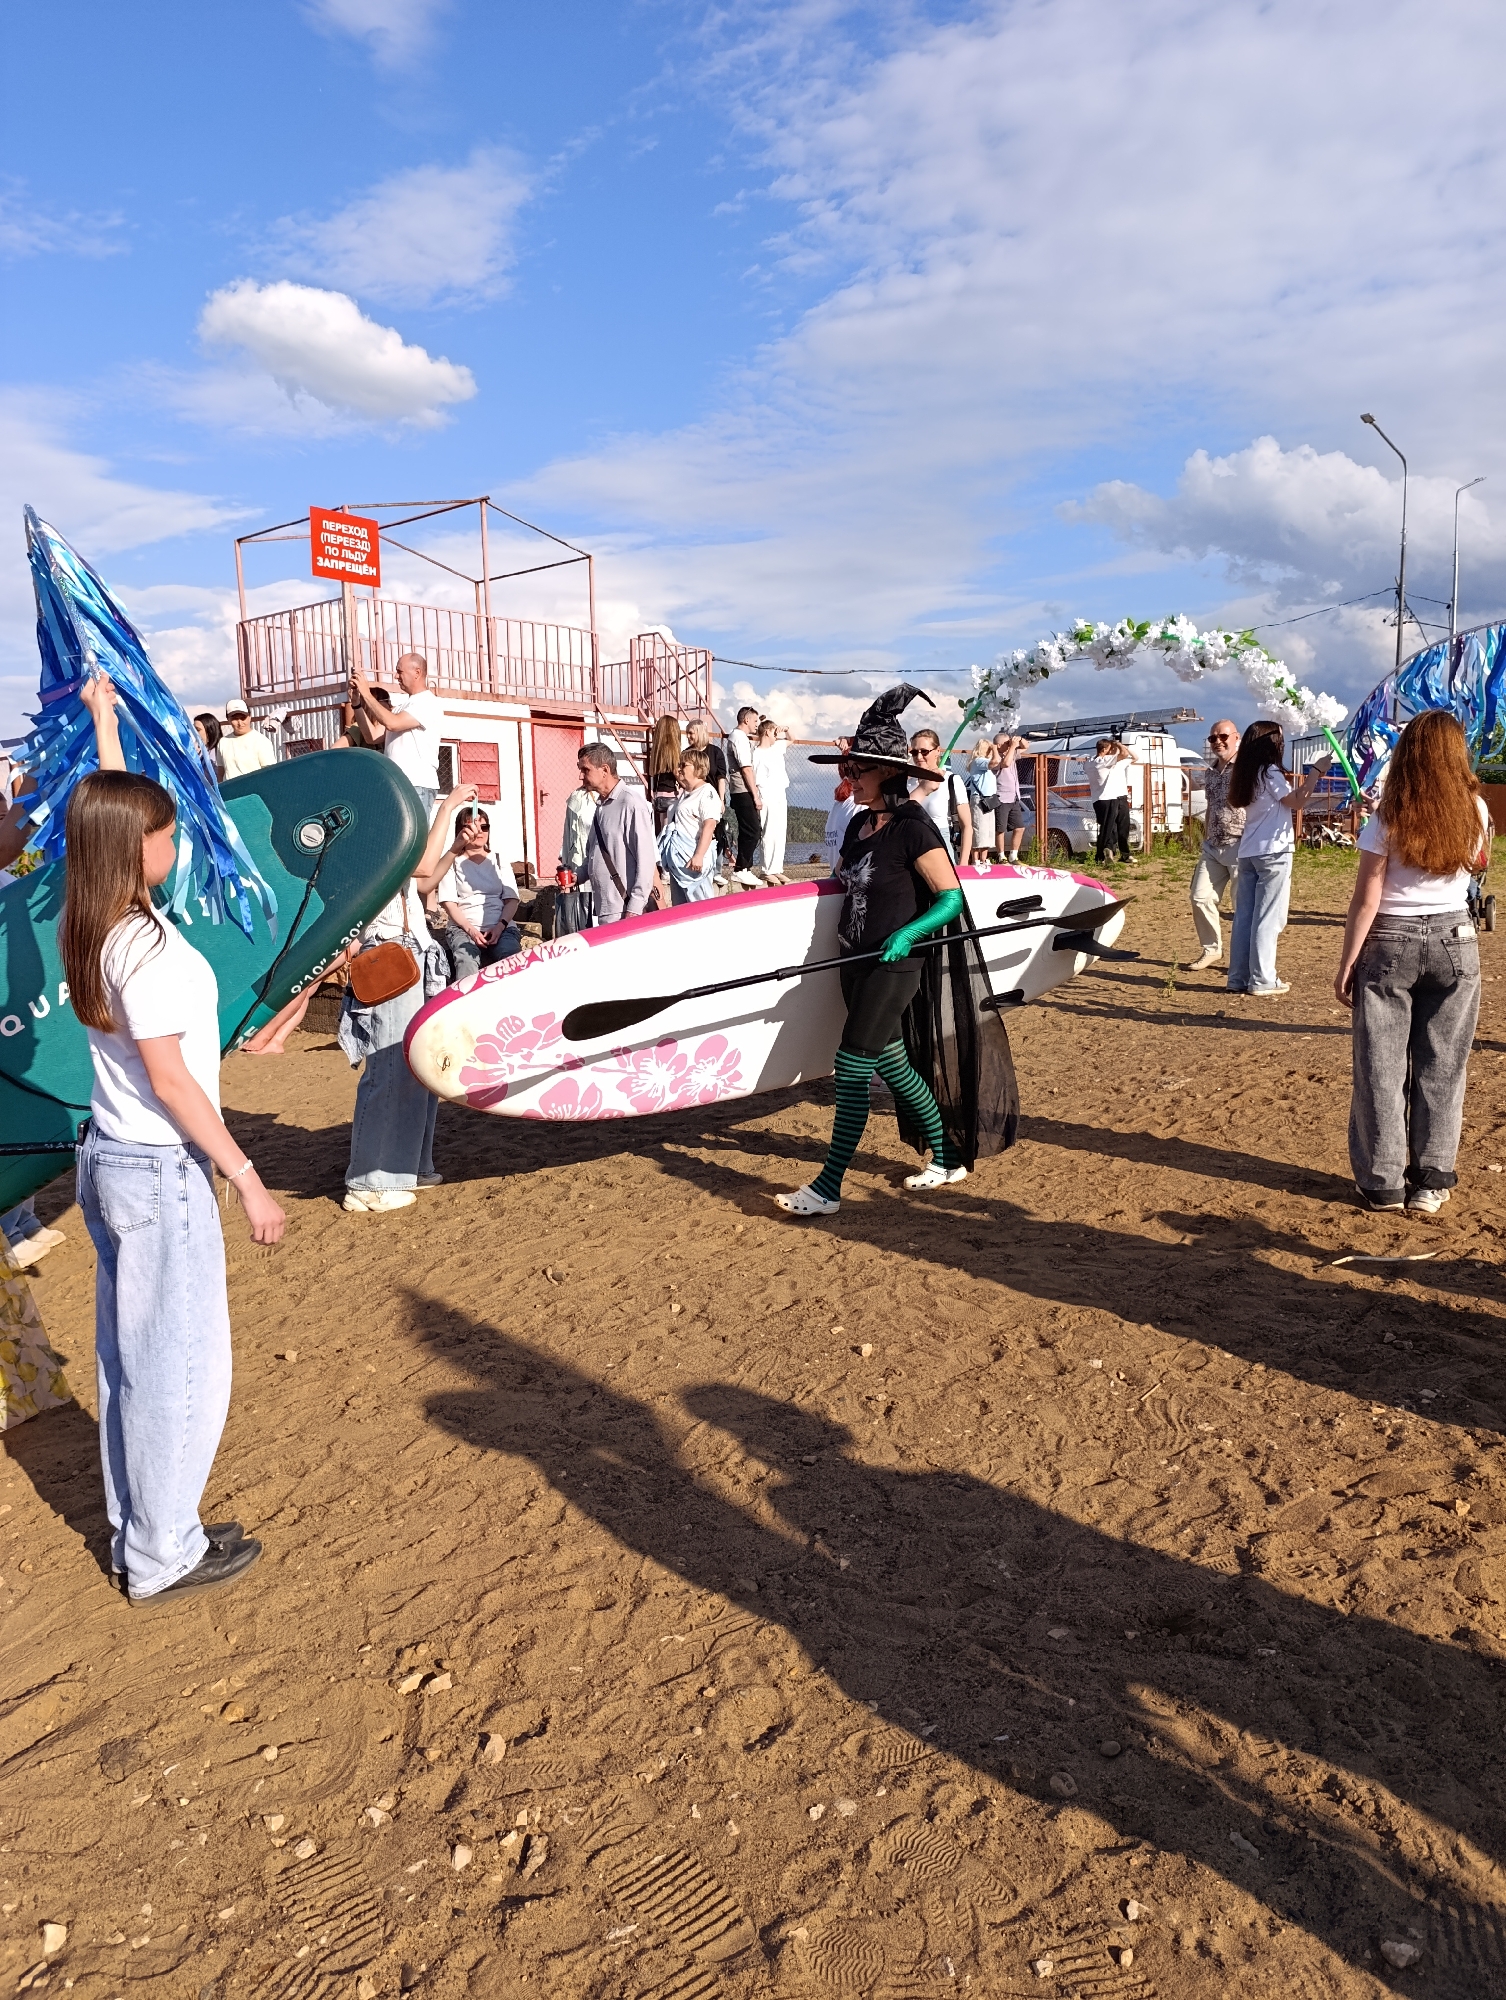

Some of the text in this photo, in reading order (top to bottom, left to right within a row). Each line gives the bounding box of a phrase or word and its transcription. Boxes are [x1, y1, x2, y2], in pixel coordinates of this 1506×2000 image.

[322, 520, 368, 540] ПЕРЕХОД
[320, 532, 371, 552] (ПЕРЕЕЗД)
[325, 546, 367, 563] ПО ЛЬДУ
[316, 556, 377, 576] ЗАПРЕЩЁН
